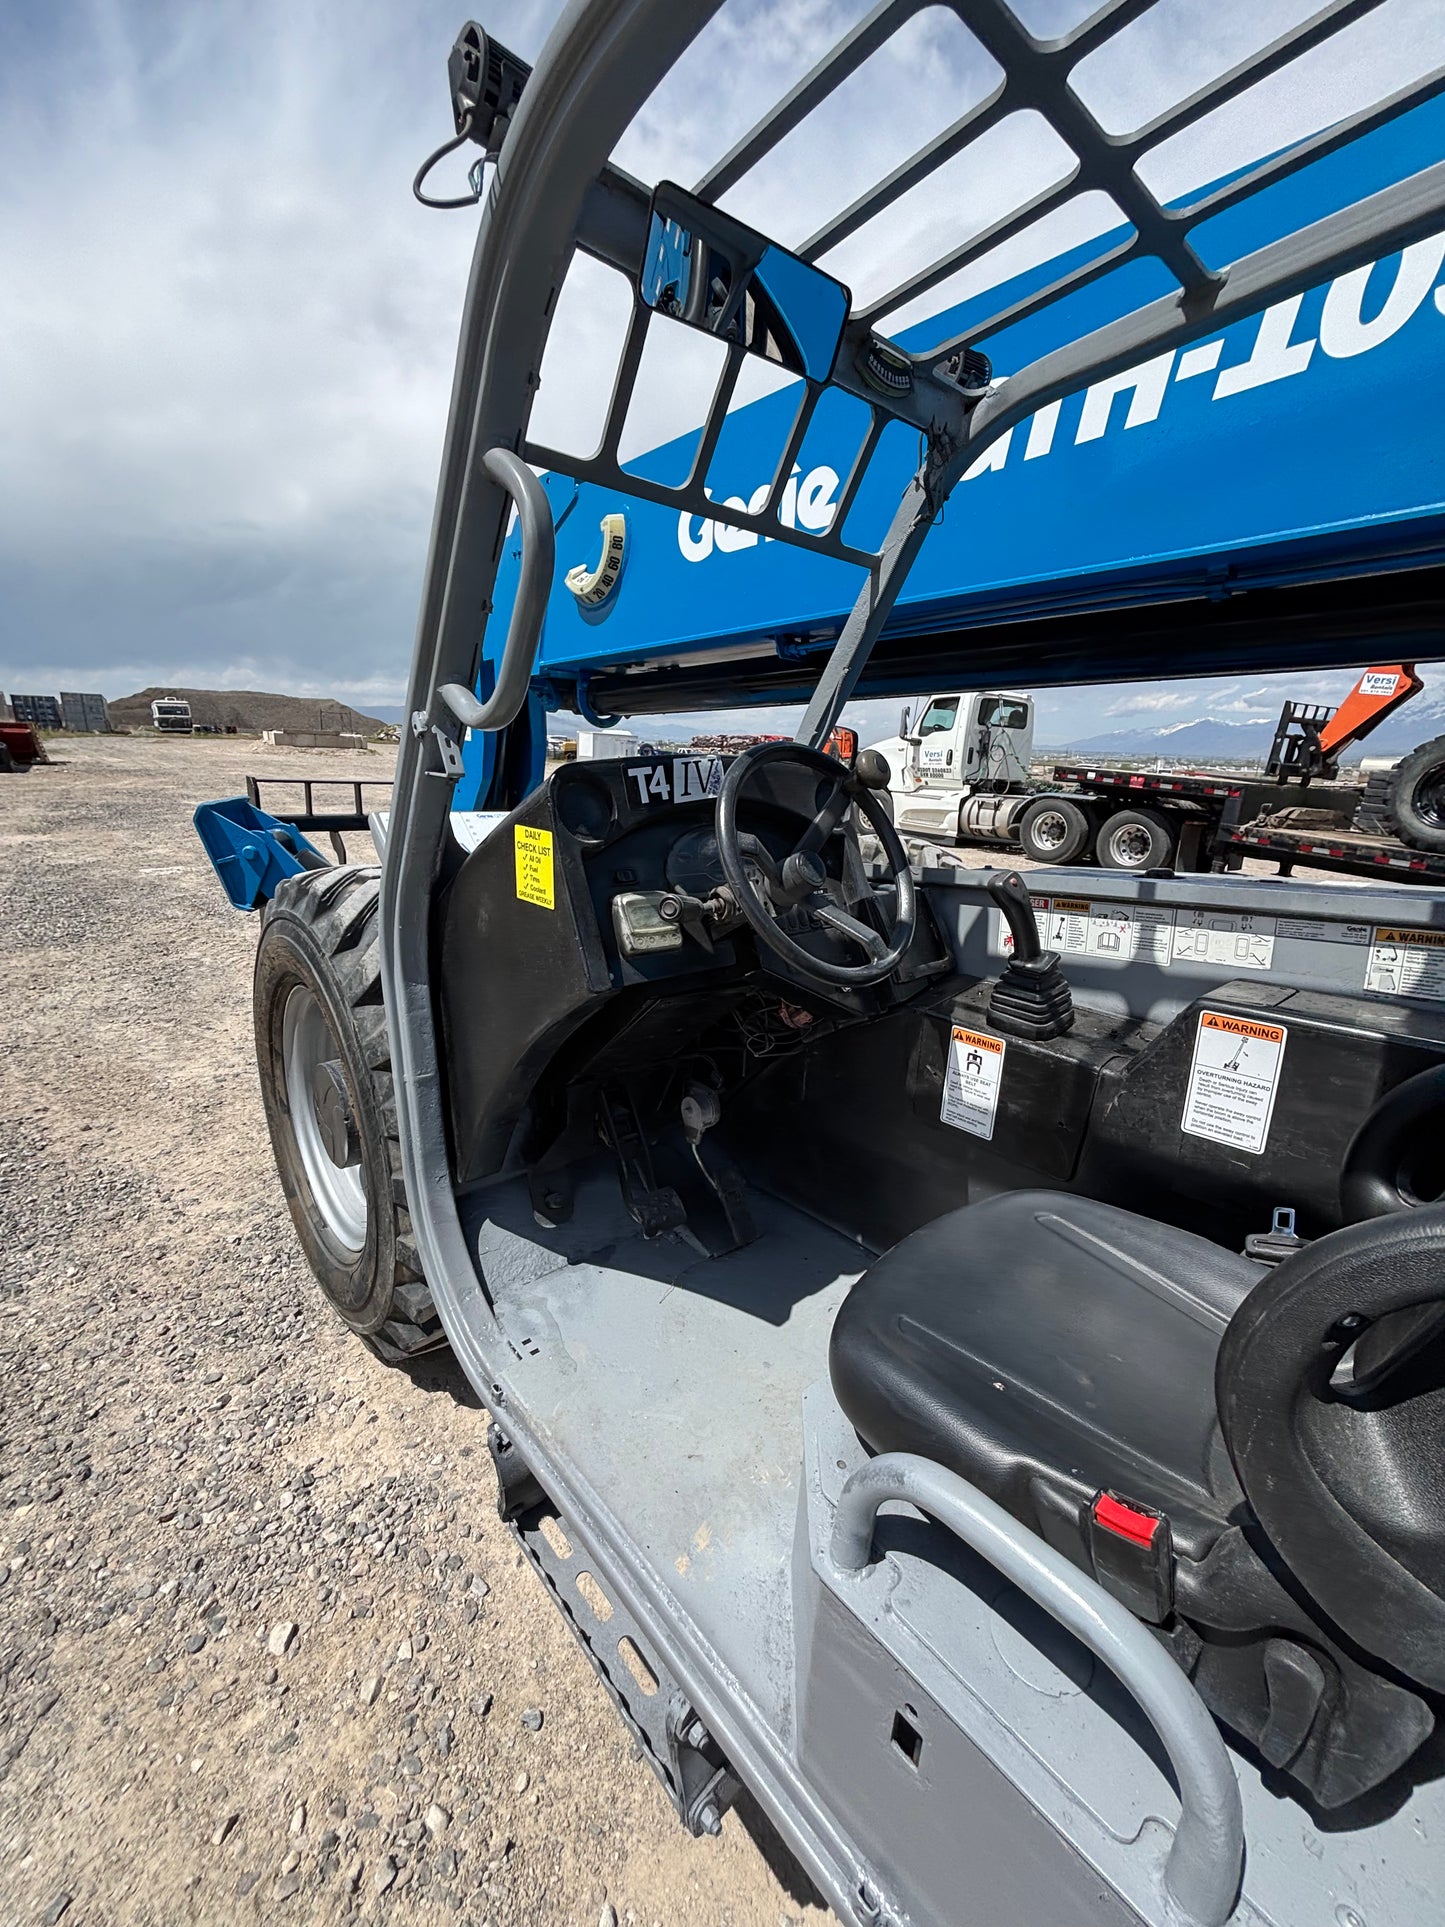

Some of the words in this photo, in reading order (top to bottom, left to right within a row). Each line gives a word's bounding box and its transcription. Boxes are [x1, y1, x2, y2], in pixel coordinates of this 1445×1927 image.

[612, 535, 623, 550] 80
[608, 556, 620, 570] 60
[603, 574, 614, 588] 40
[593, 587, 606, 599] 20
[1367, 674, 1397, 685] Versi
[628, 765, 670, 804] T4
[524, 830, 542, 840] DAILY
[517, 841, 537, 854] CHECK
[538, 846, 550, 856] LIST
[1399, 932, 1445, 944] WARNIN
[1222, 1020, 1279, 1040] WARNING
[965, 1034, 1001, 1052] WARNING
[1197, 1070, 1242, 1084] OVERTURNING
[1244, 1081, 1270, 1092] HAZARD
